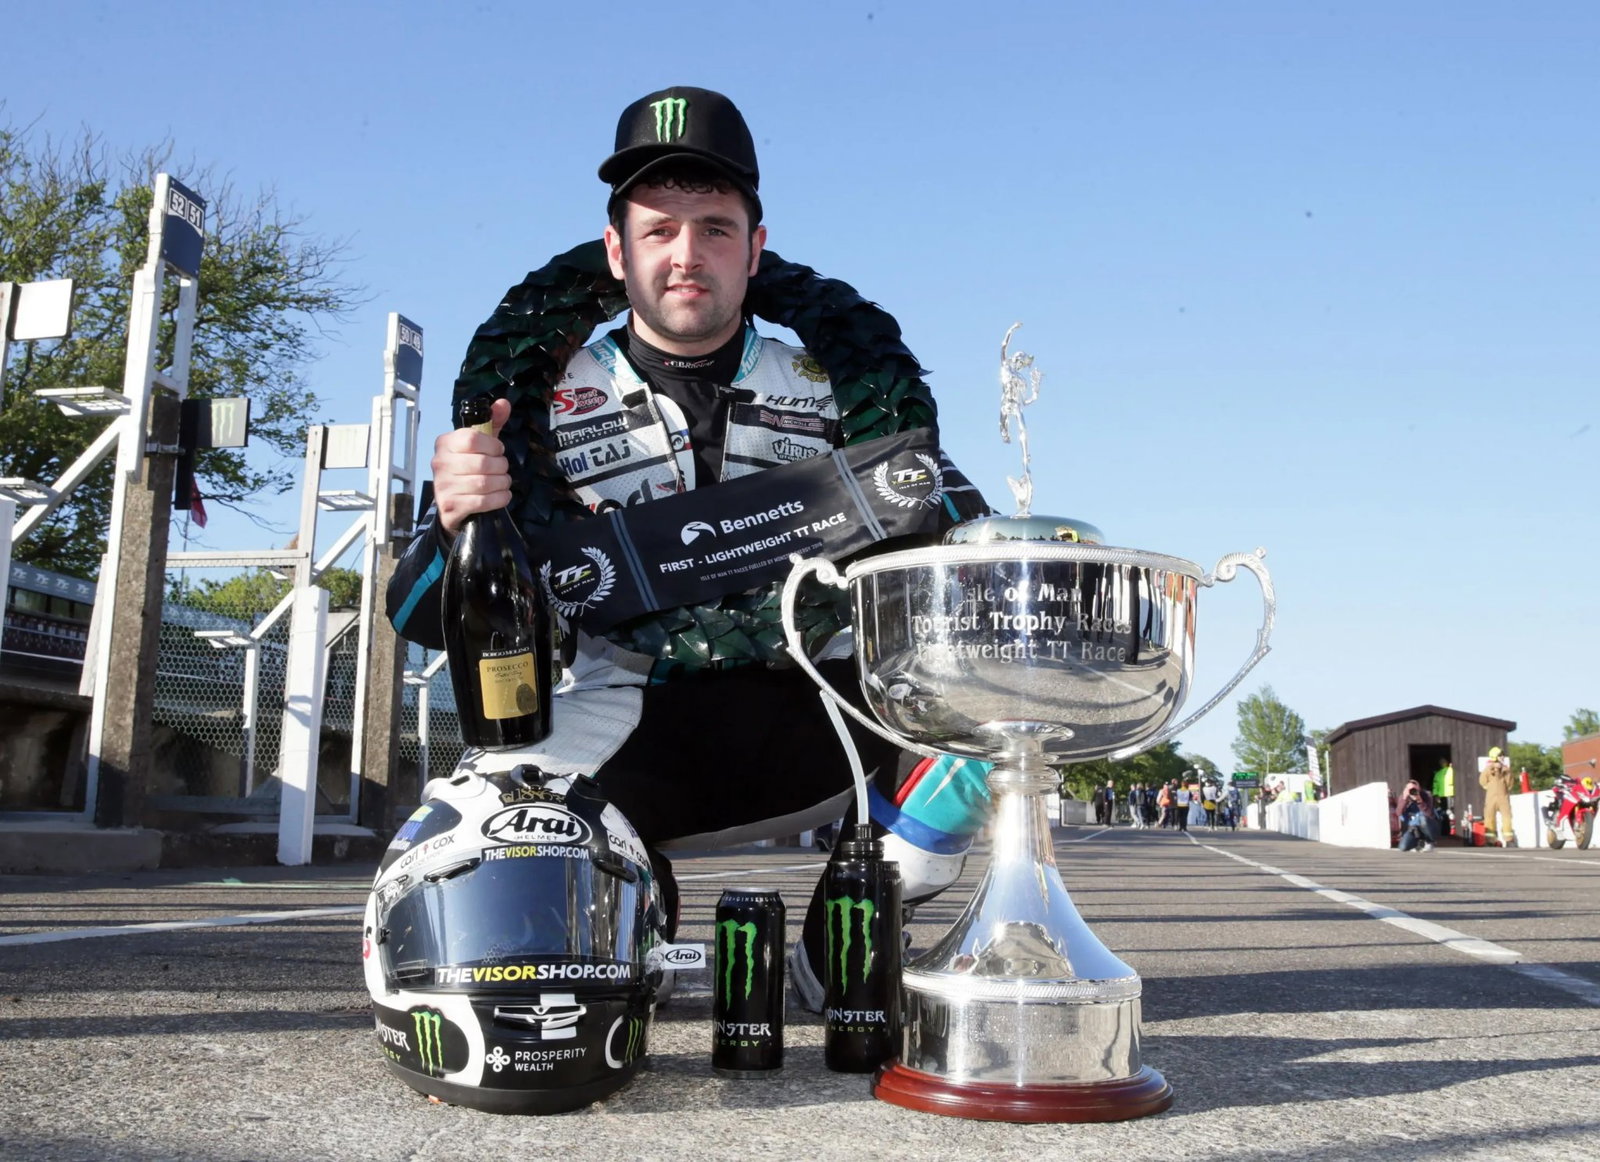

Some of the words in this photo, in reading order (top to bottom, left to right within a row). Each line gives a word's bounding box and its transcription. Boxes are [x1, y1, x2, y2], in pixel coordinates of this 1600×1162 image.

[171, 192, 185, 216] 52
[189, 205, 201, 227] 51
[720, 500, 804, 534] Bennetts
[659, 558, 695, 574] FIRST
[705, 532, 792, 564] LIGHTWEIGHT
[793, 526, 809, 538] TT
[811, 512, 847, 533] RACE
[989, 610, 1067, 636] Trophy
[1047, 640, 1073, 659] TT
[1081, 641, 1126, 662] Race
[486, 661, 529, 672] PROSECCO
[487, 809, 578, 837] Arai
[484, 845, 589, 861] THEVISORSHOP.COM
[671, 949, 697, 961] Arai
[437, 964, 631, 984] THEVISORSHOP.COM
[826, 1006, 886, 1023] ONSTER
[515, 1047, 587, 1061] PROSPERITY
[515, 1062, 554, 1072] WEALTH
